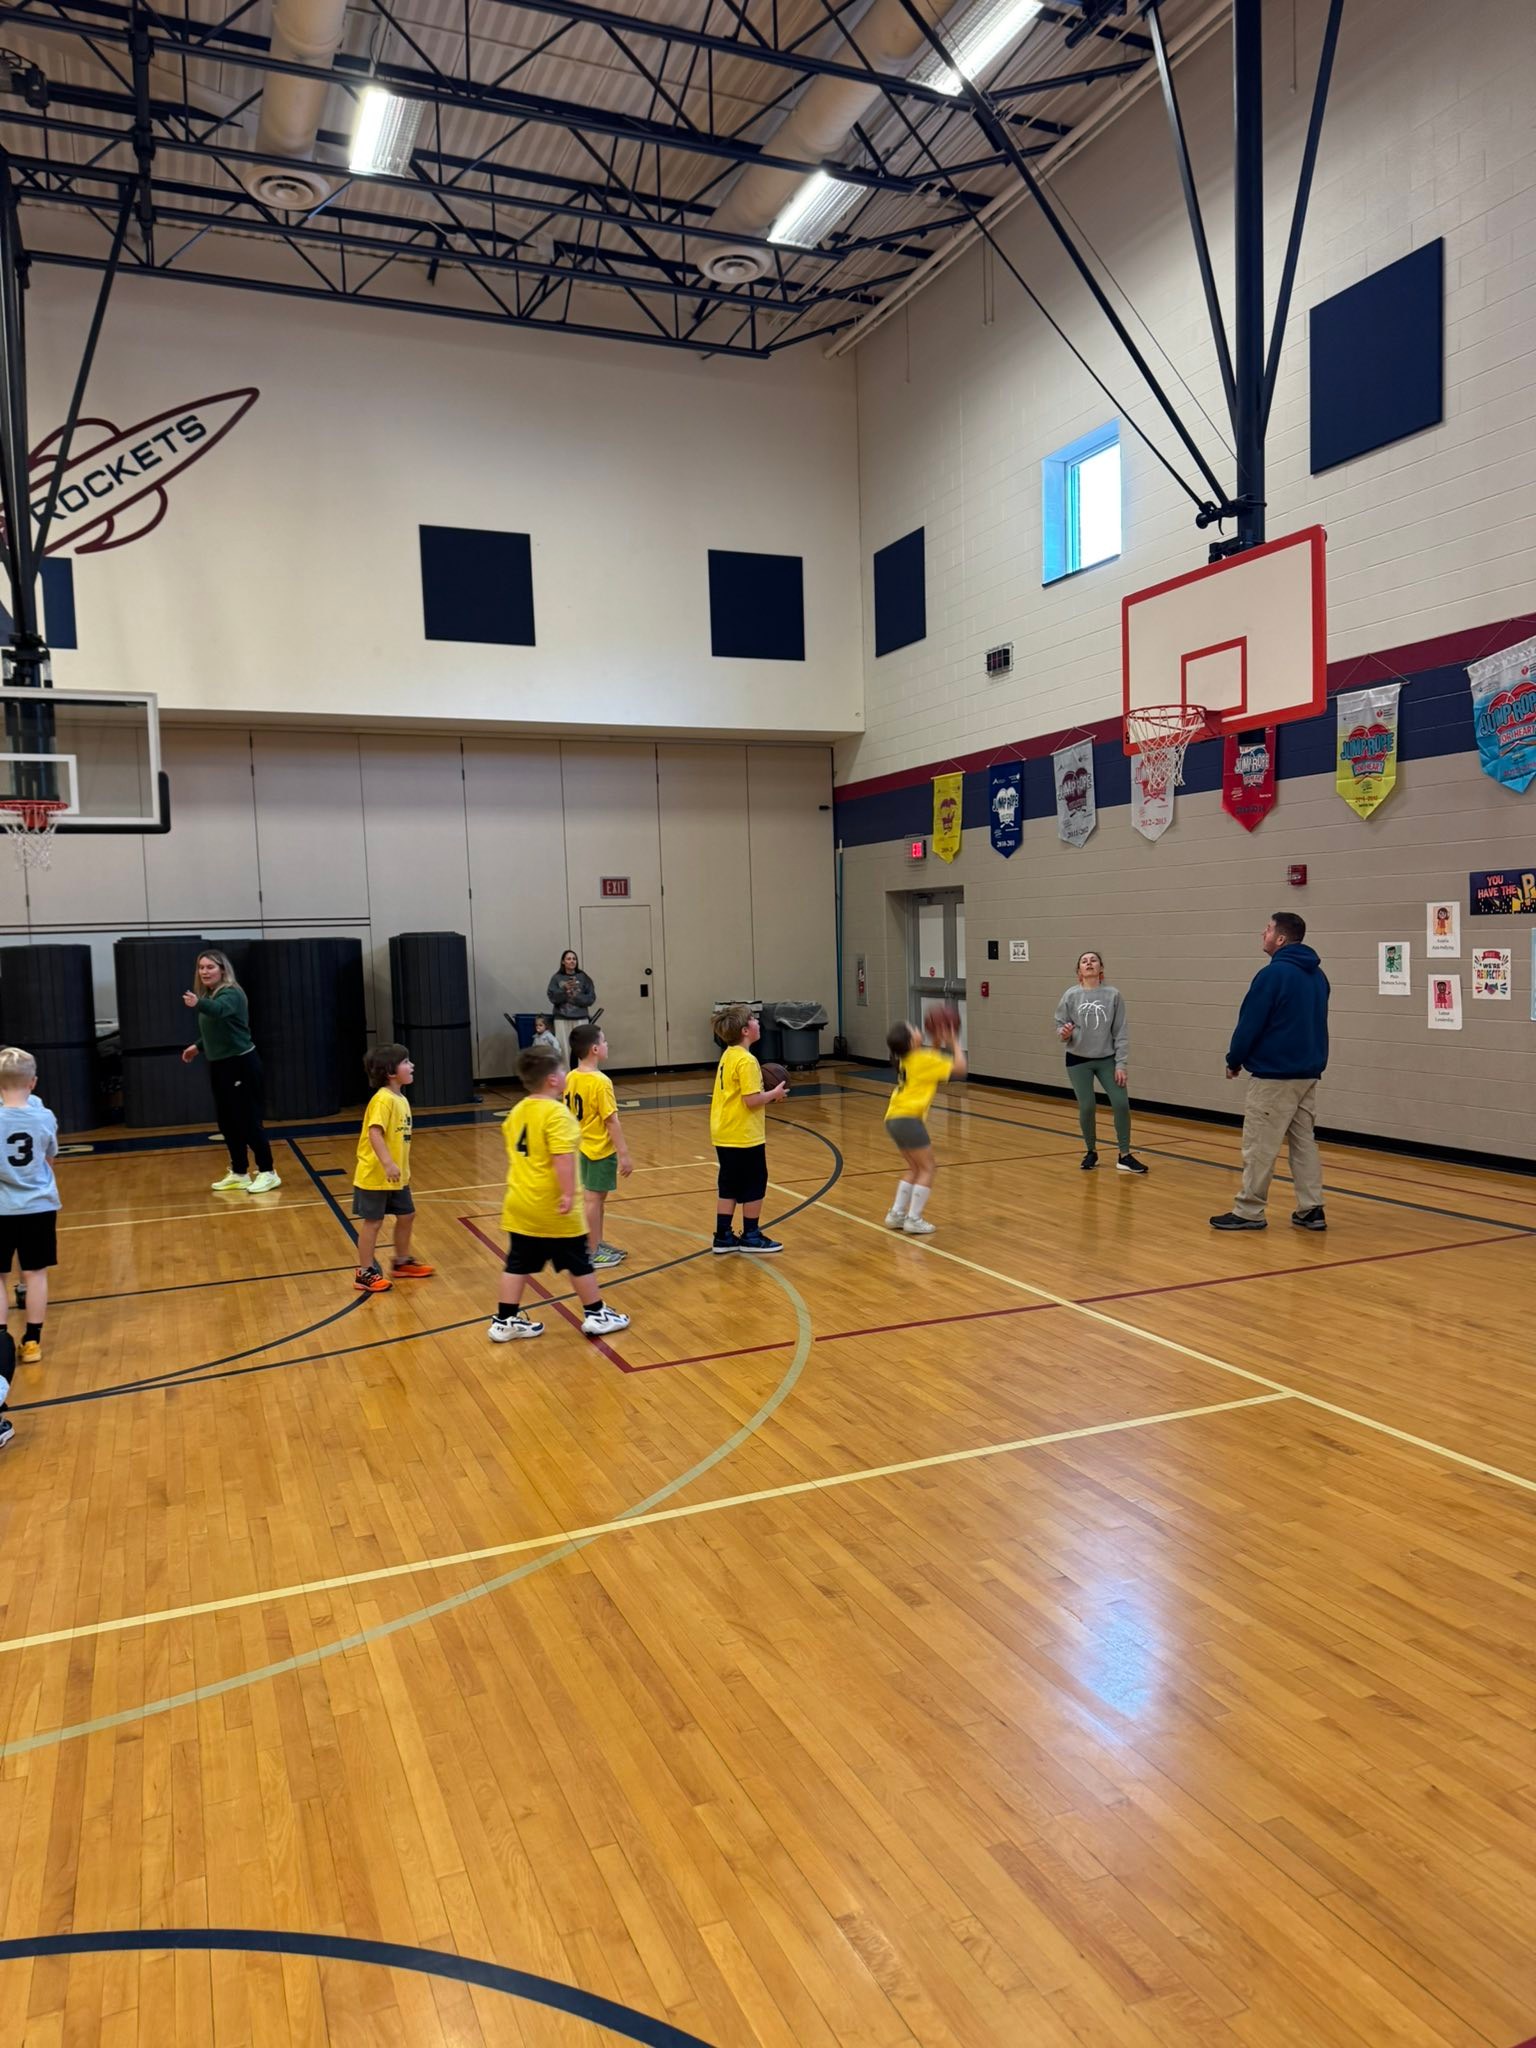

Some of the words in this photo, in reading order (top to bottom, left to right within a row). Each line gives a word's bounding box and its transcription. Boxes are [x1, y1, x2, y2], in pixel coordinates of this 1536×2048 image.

[29, 414, 207, 527] ROCKETS
[1480, 702, 1512, 736] JUMP
[1512, 692, 1536, 723] ROP
[1340, 737, 1367, 760] JUMP
[1367, 732, 1394, 756] ROPE
[1513, 725, 1536, 740] HEART
[606, 880, 625, 895] EXIT
[1477, 886, 1500, 899] HAVE
[1500, 884, 1518, 896] THE
[1486, 874, 1504, 887] YOU
[565, 1091, 584, 1122] 10
[6, 1131, 34, 1167] 3
[516, 1123, 529, 1157] 4
